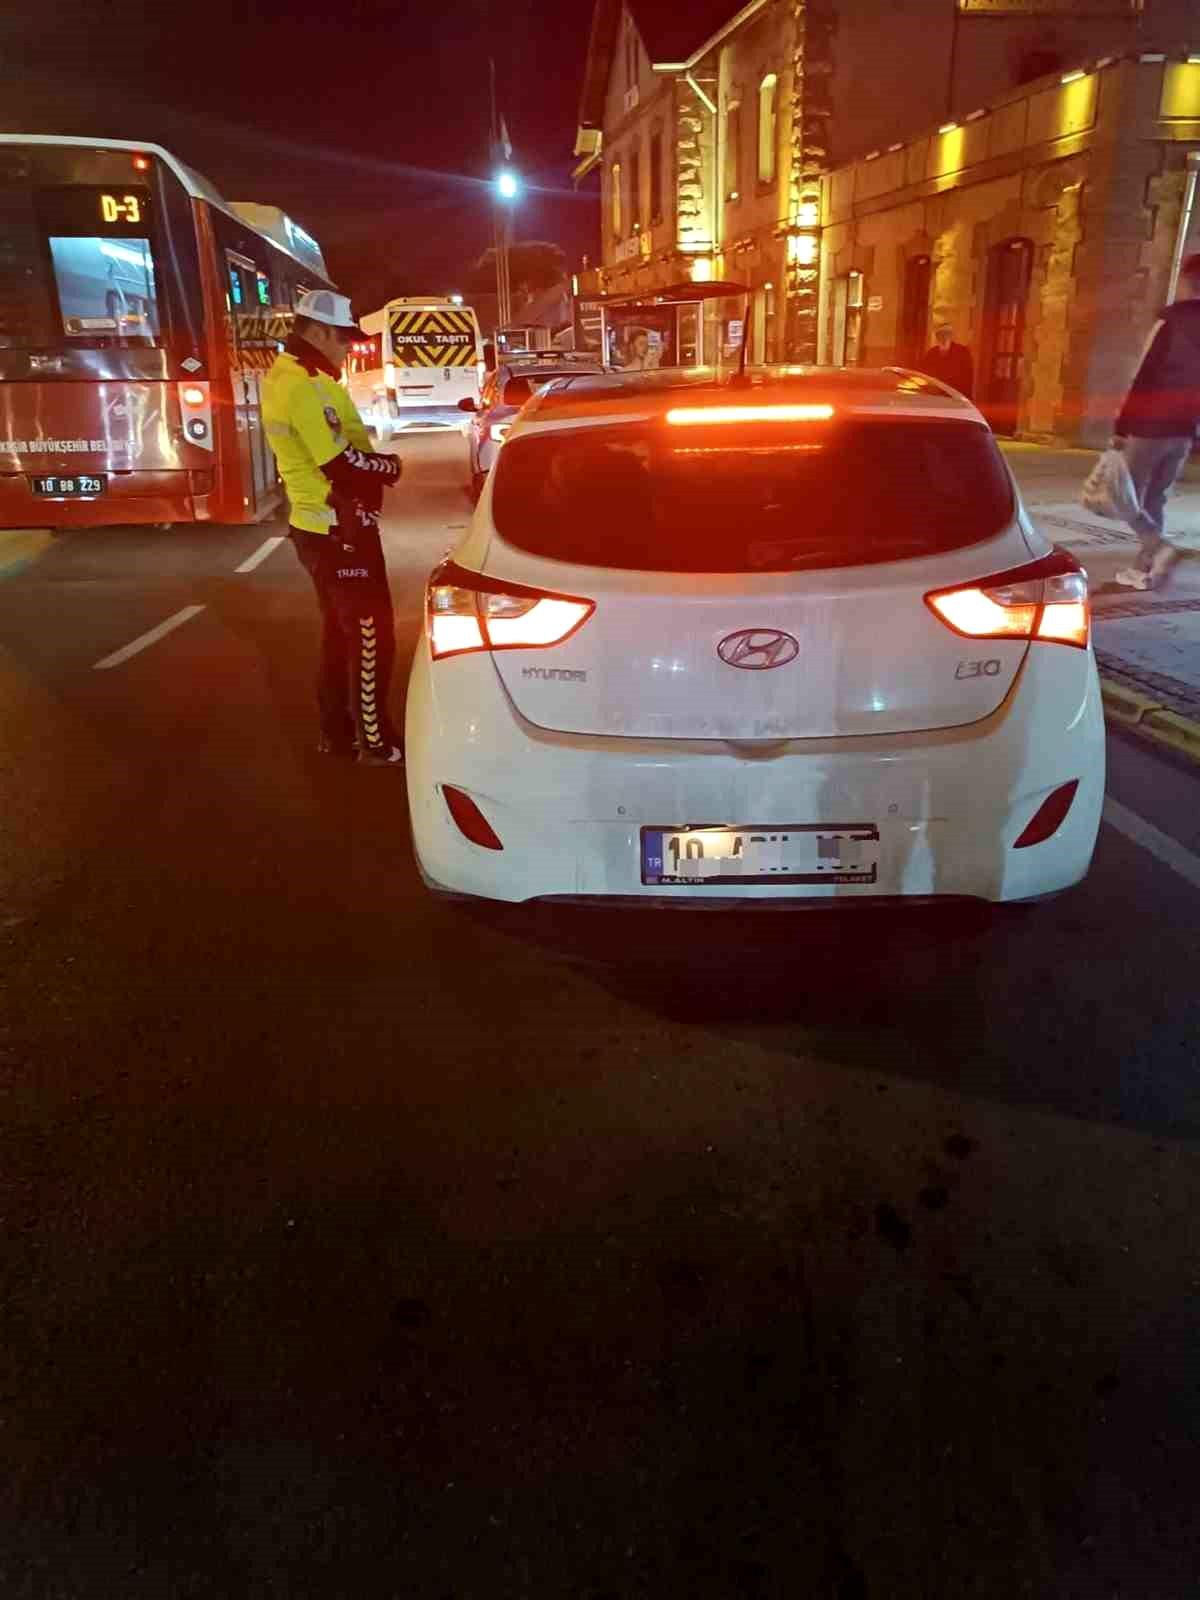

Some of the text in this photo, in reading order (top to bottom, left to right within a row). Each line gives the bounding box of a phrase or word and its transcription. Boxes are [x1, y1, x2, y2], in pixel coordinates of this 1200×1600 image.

[101, 194, 140, 223] D-3
[397, 335, 469, 345] OKUL TAŞITI
[40, 480, 53, 492] 10
[80, 480, 101, 492] 229
[648, 857, 661, 868] TR
